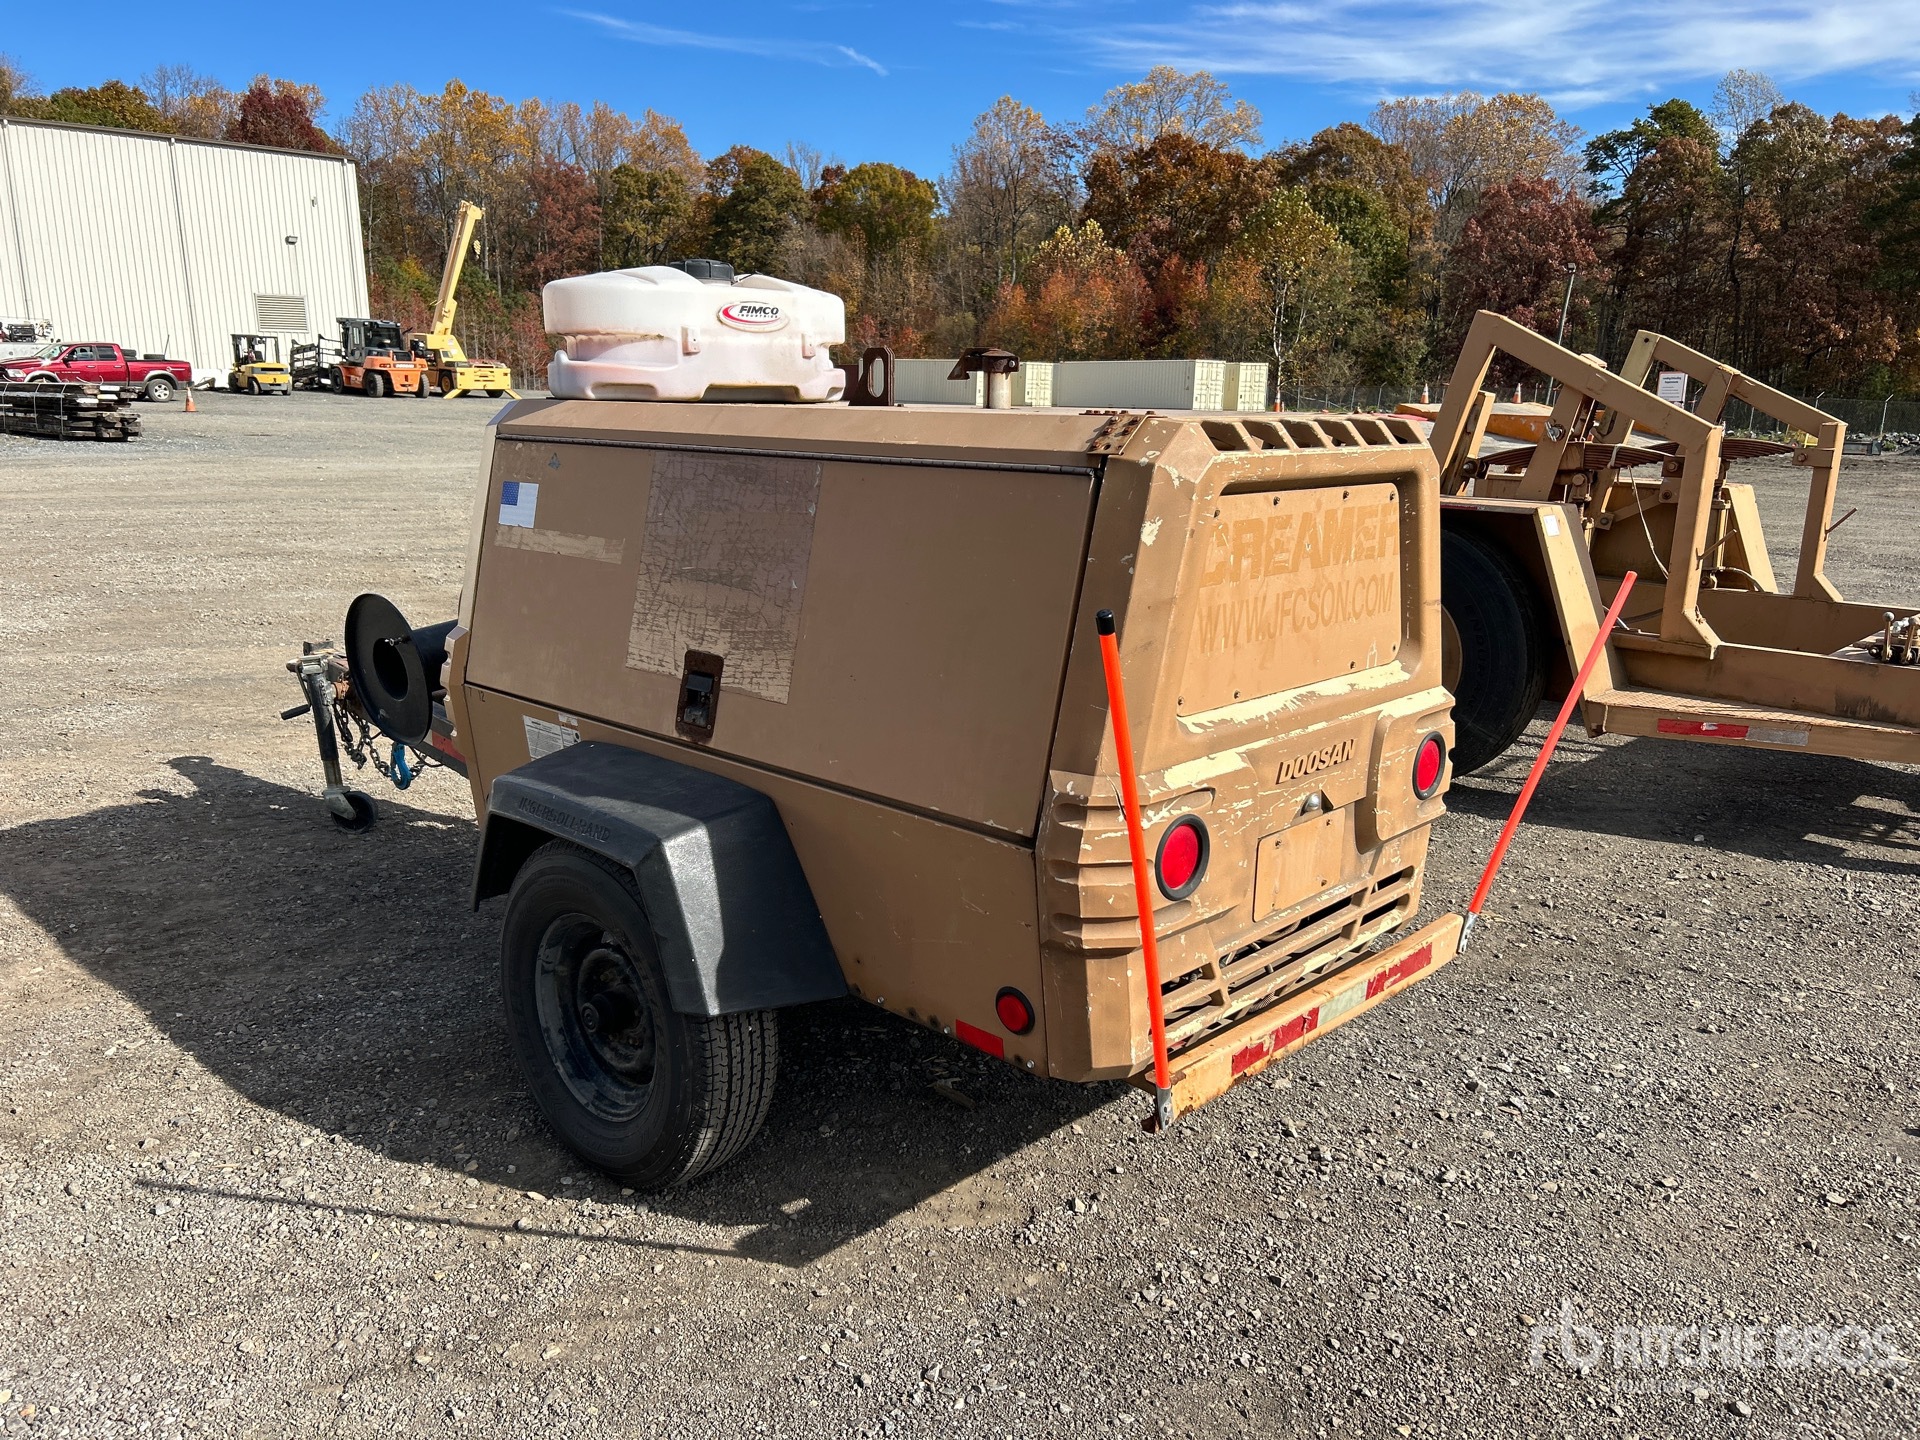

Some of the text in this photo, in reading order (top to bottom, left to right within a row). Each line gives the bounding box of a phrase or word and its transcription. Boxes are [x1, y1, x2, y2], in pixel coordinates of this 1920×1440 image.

[739, 305, 779, 315] FIMCO
[1198, 572, 1395, 655] WWW.JFCSON.COM
[1275, 739, 1357, 785] DOOSAN
